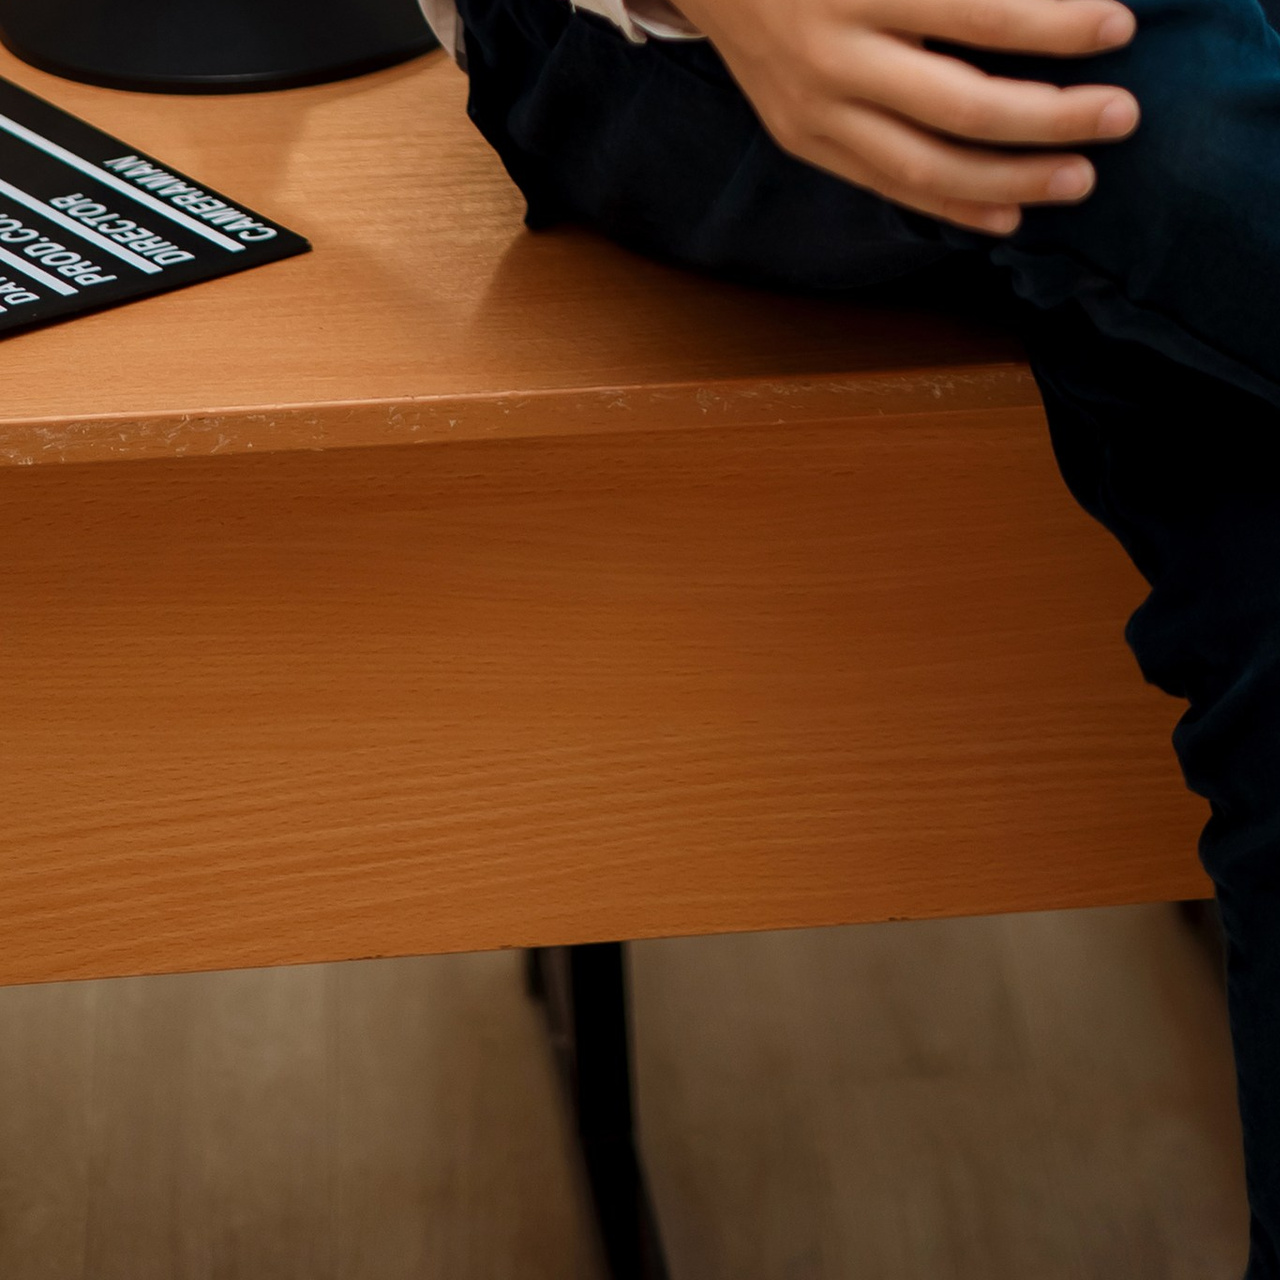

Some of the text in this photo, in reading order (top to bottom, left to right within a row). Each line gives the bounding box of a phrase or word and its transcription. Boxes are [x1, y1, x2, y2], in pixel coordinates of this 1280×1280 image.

[49, 193, 196, 266] DIRECTOR
[103, 155, 278, 241] CAMERAMAN
[0, 276, 41, 306] DA
